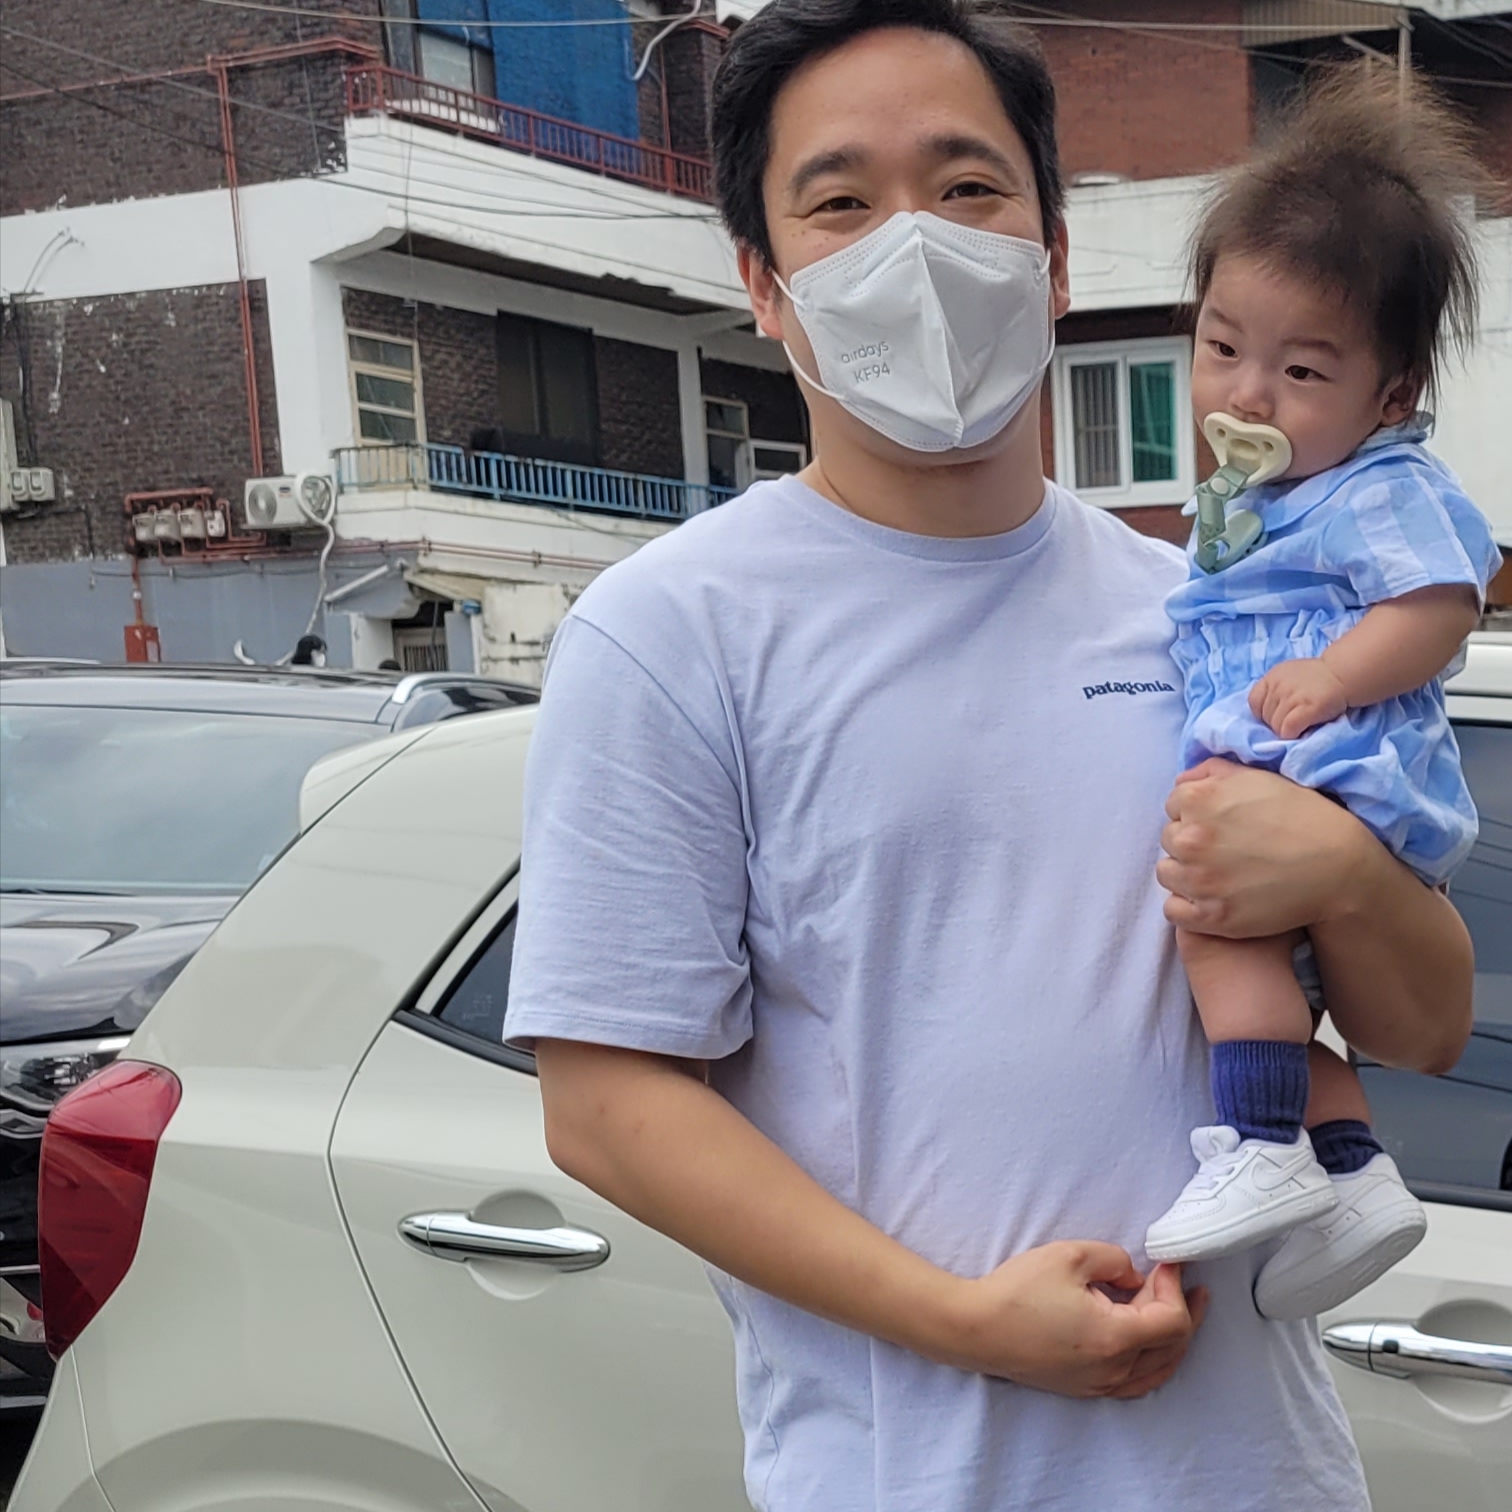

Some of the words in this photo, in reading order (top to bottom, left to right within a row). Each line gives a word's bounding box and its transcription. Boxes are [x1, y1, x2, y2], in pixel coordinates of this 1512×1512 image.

[841, 341, 889, 364] airdays
[854, 362, 890, 383] KF94
[1082, 680, 1176, 700] patagonia
